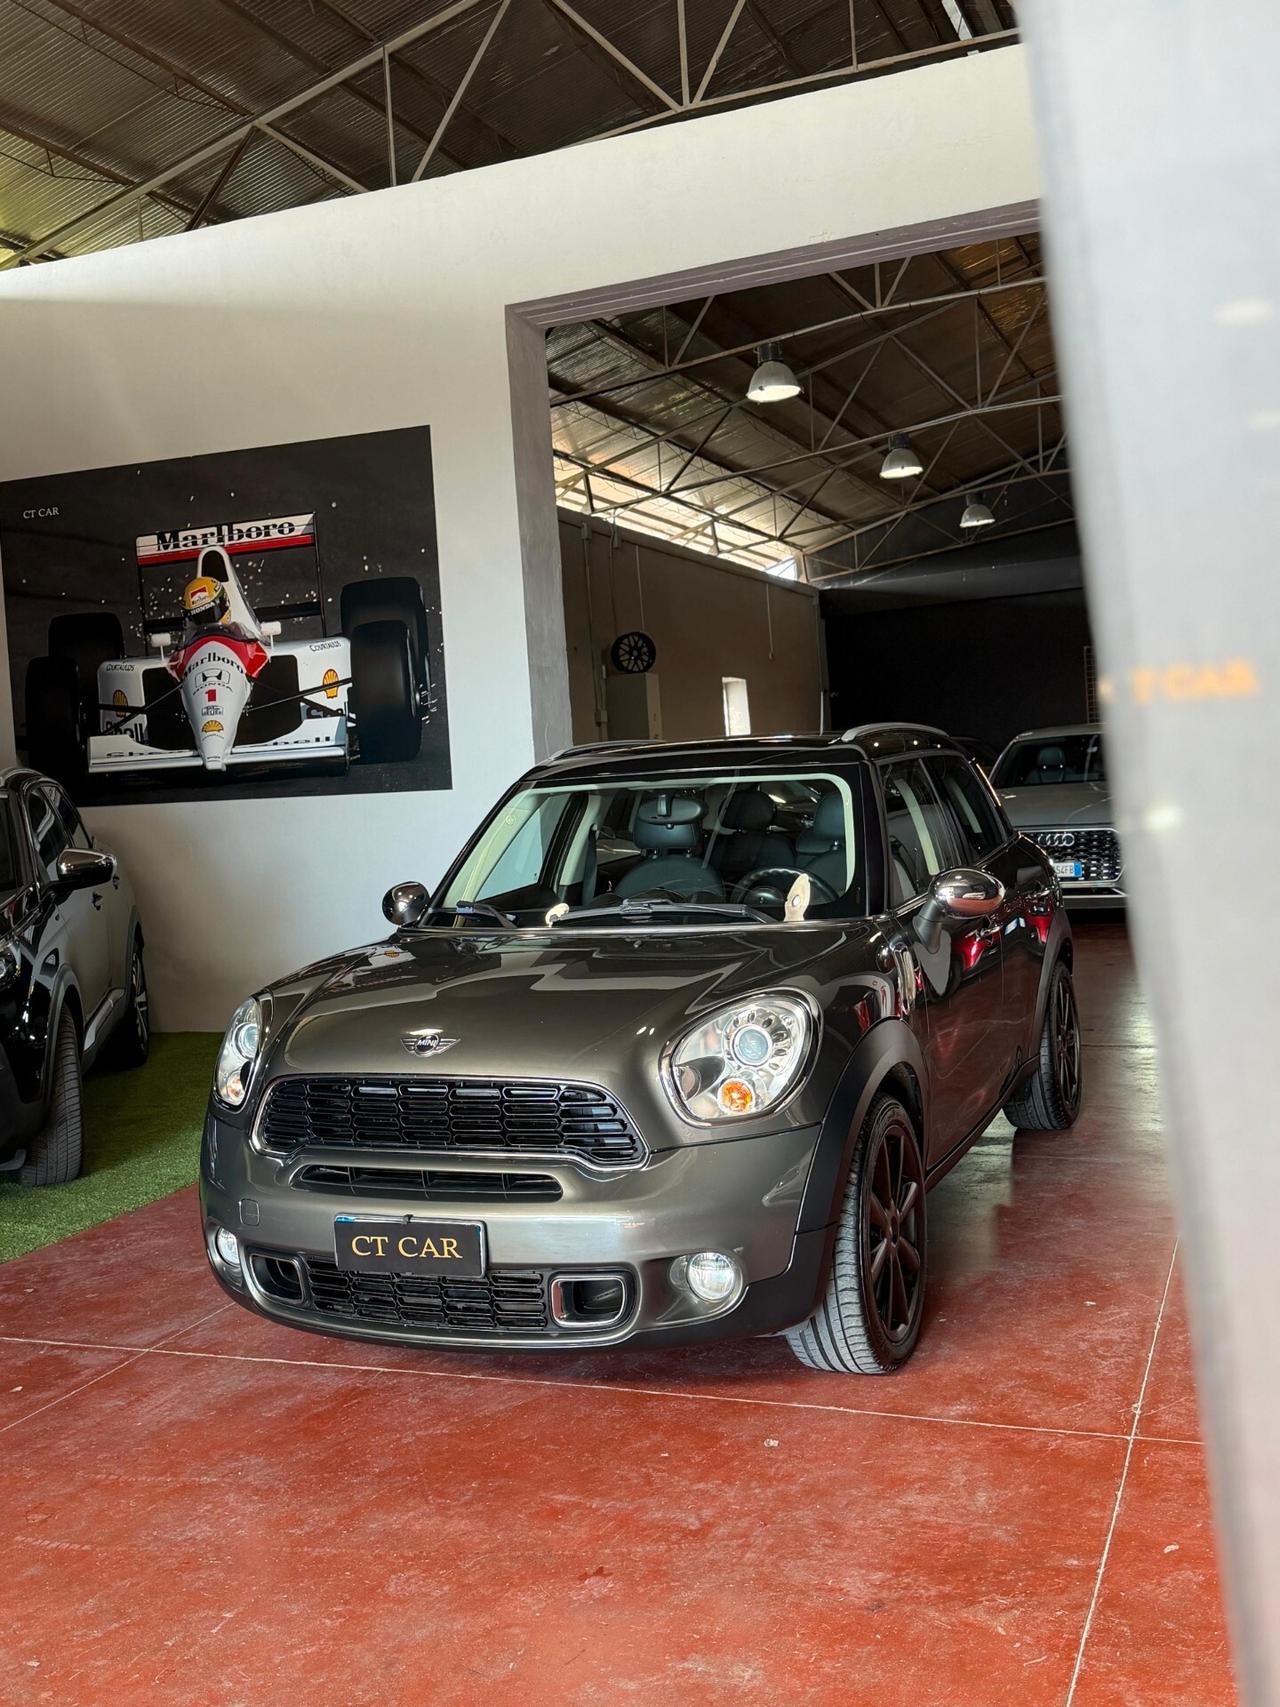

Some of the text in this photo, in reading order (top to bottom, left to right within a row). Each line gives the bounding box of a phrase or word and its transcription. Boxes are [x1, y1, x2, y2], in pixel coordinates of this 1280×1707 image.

[23, 506, 60, 519] CT CAR
[156, 521, 296, 551] Marlboro
[205, 689, 216, 702] 1
[351, 1235, 464, 1259] CT CAR
